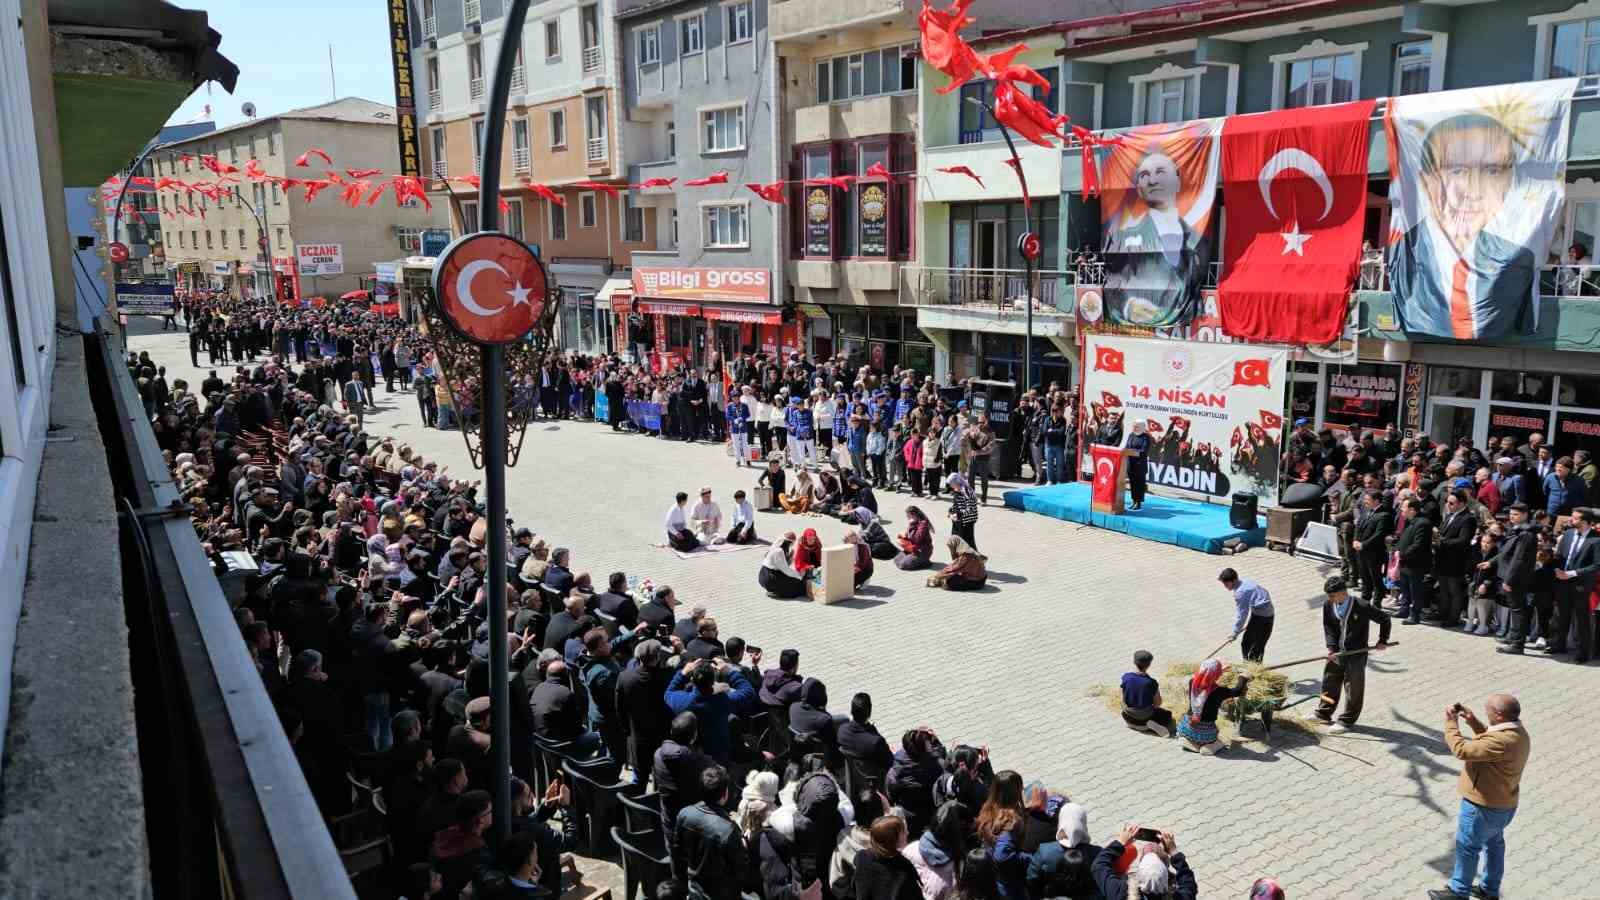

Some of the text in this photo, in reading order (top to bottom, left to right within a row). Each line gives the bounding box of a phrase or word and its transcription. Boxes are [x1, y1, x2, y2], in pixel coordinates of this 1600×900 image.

[301, 245, 338, 256] ECZANE
[660, 271, 766, 288] Bilgi gross
[1129, 384, 1227, 409] 14 NİSAN
[1146, 456, 1217, 493] YADİN
